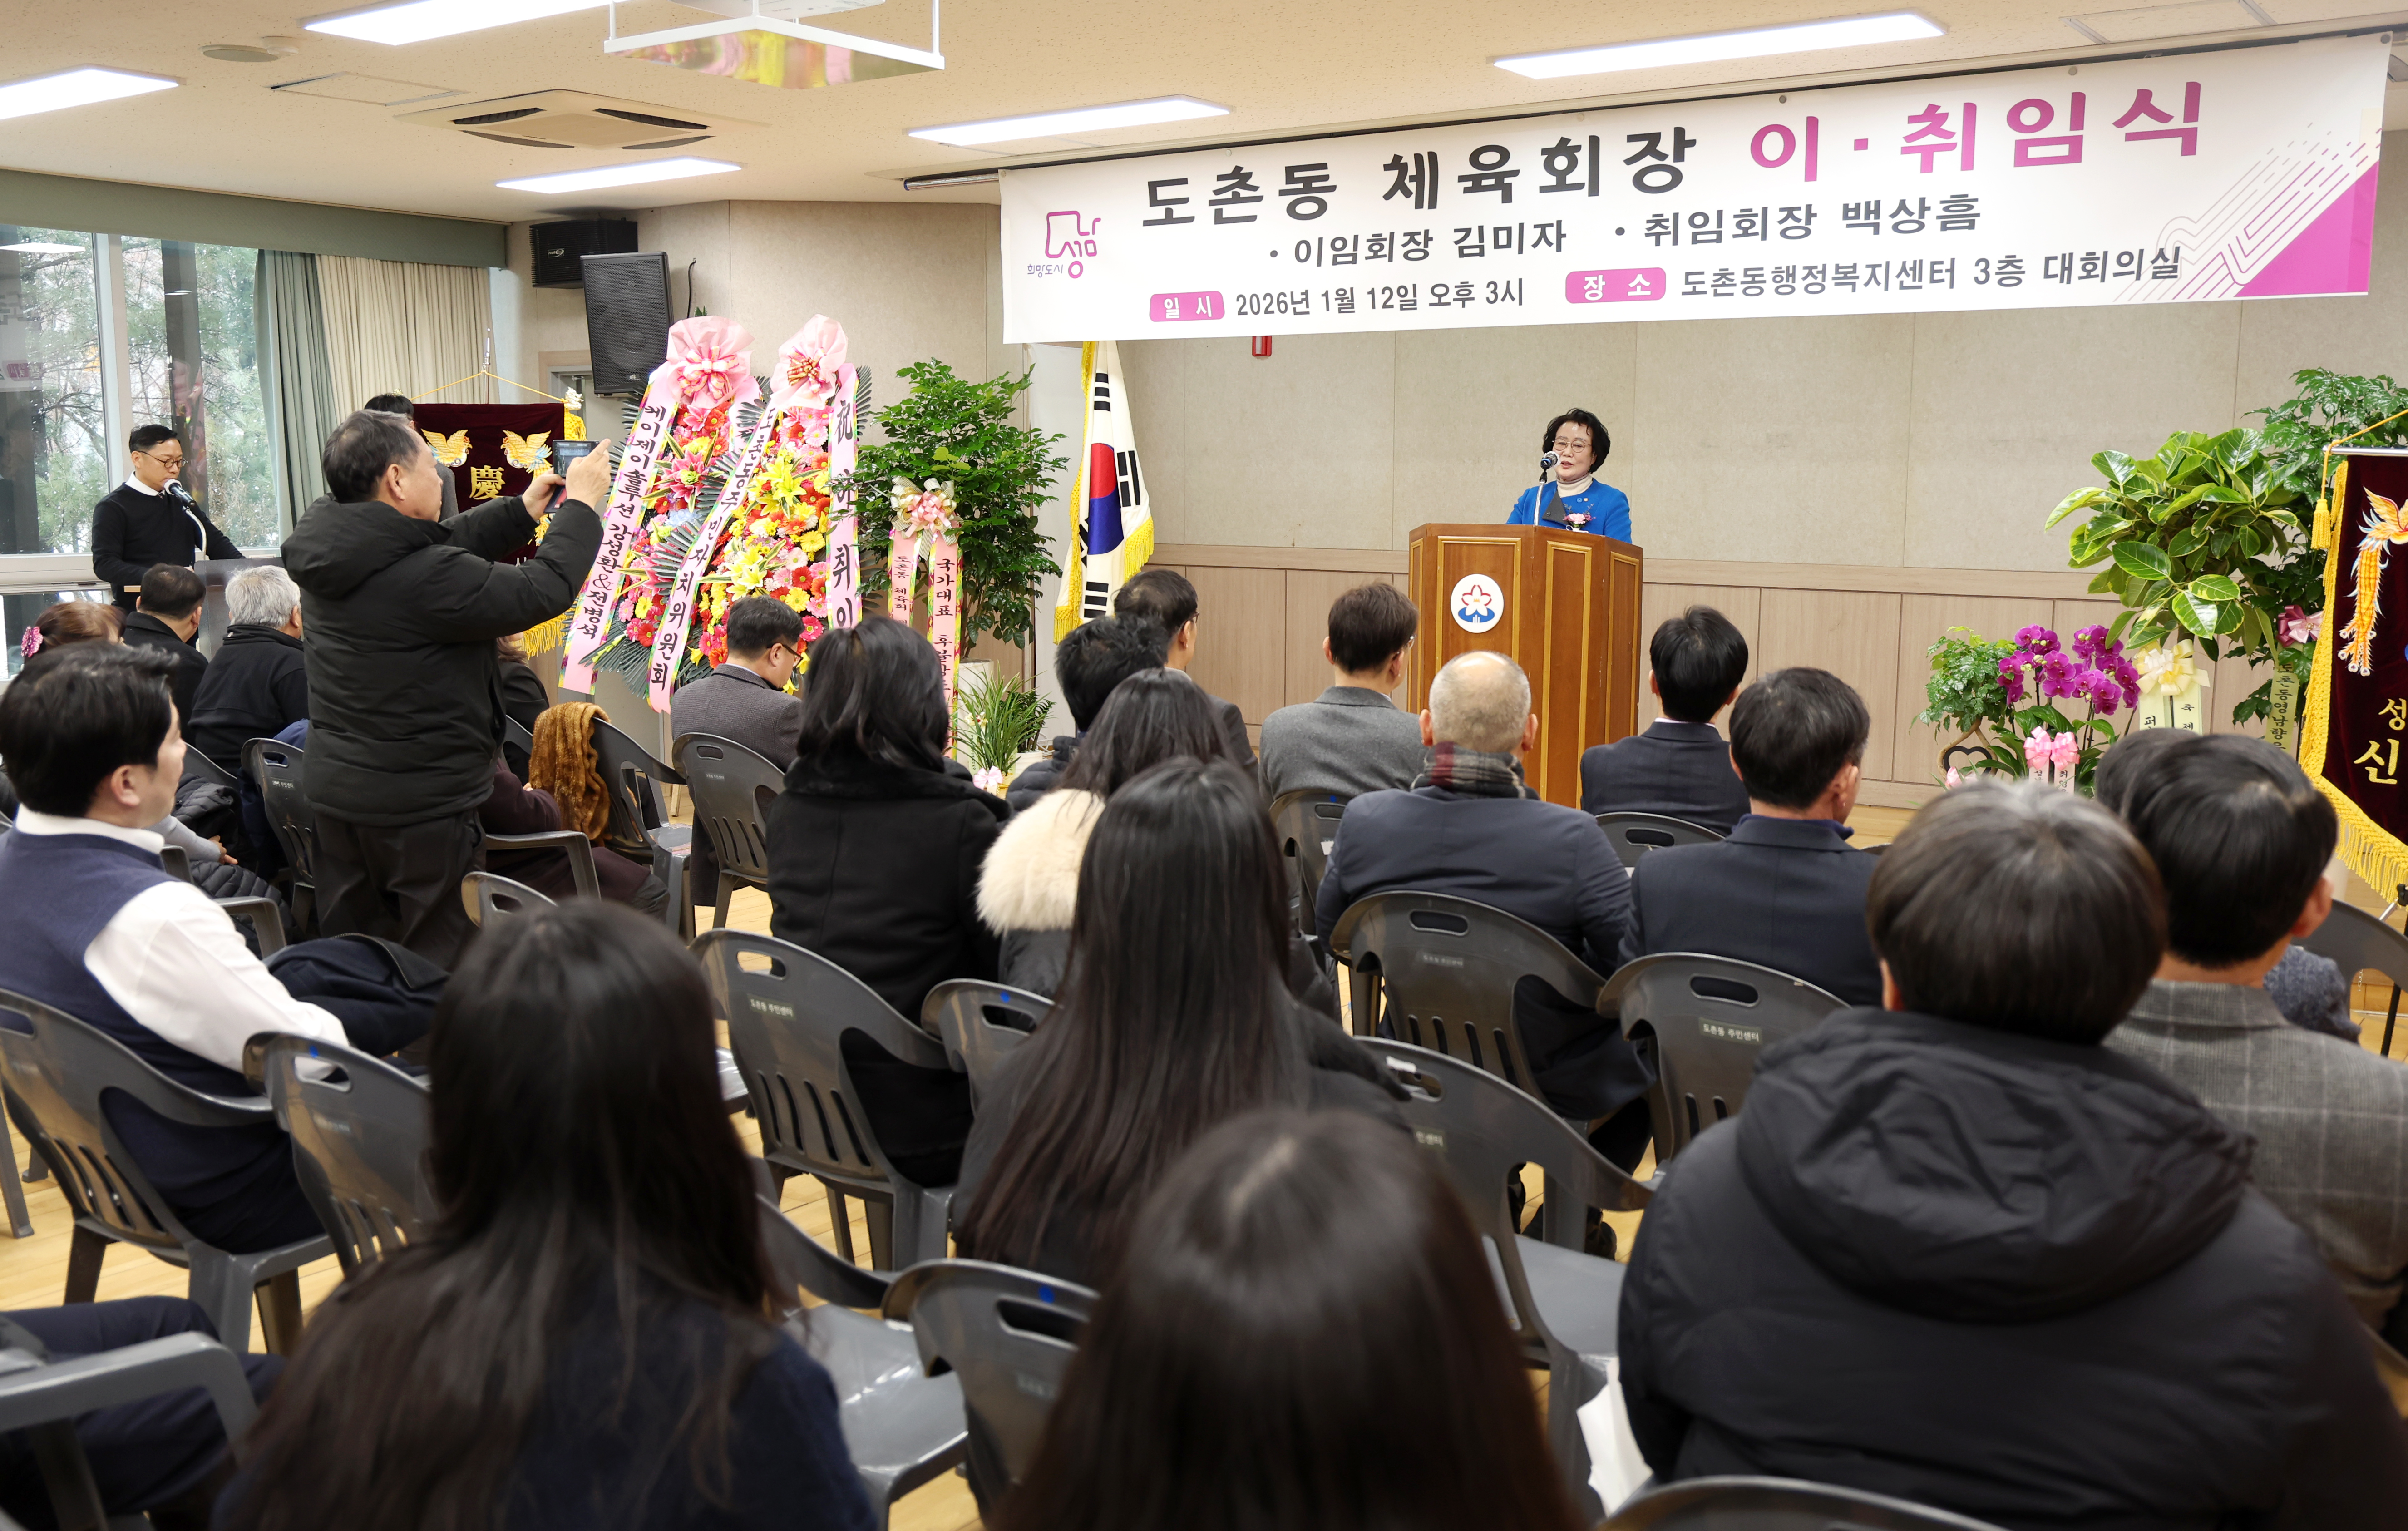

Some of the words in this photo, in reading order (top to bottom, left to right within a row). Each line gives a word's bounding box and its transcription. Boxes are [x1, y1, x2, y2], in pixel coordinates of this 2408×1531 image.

[1142, 162, 1337, 227] 도촌동
[1382, 126, 1697, 211] 체육회장
[1294, 229, 1433, 267] 이임회장
[1452, 220, 1567, 258] 김미자
[1644, 204, 1817, 247] 취임회장
[1842, 194, 1980, 235] 백상흠
[1027, 263, 1063, 278] 희망도시
[1236, 289, 1310, 316] 2026년
[1321, 287, 1356, 314] 1월
[1367, 283, 1417, 311] 12일
[1428, 281, 1475, 308] 오후
[1485, 277, 1523, 306] 3시
[1681, 257, 1955, 297] 도촌동행정복지센터
[1974, 255, 2026, 287] 3층
[2043, 246, 2181, 281] 대회의실
[834, 400, 853, 445] 祝
[613, 405, 666, 519] 케이제이솔루션
[469, 465, 506, 500] 慶
[894, 556, 912, 579] 도촌동
[934, 558, 956, 617] 국가대표
[893, 587, 909, 611] 체육회
[2181, 703, 2195, 712] 축
[1703, 1023, 1725, 1037] 도촌동
[1727, 1028, 1760, 1042] 주민센터
